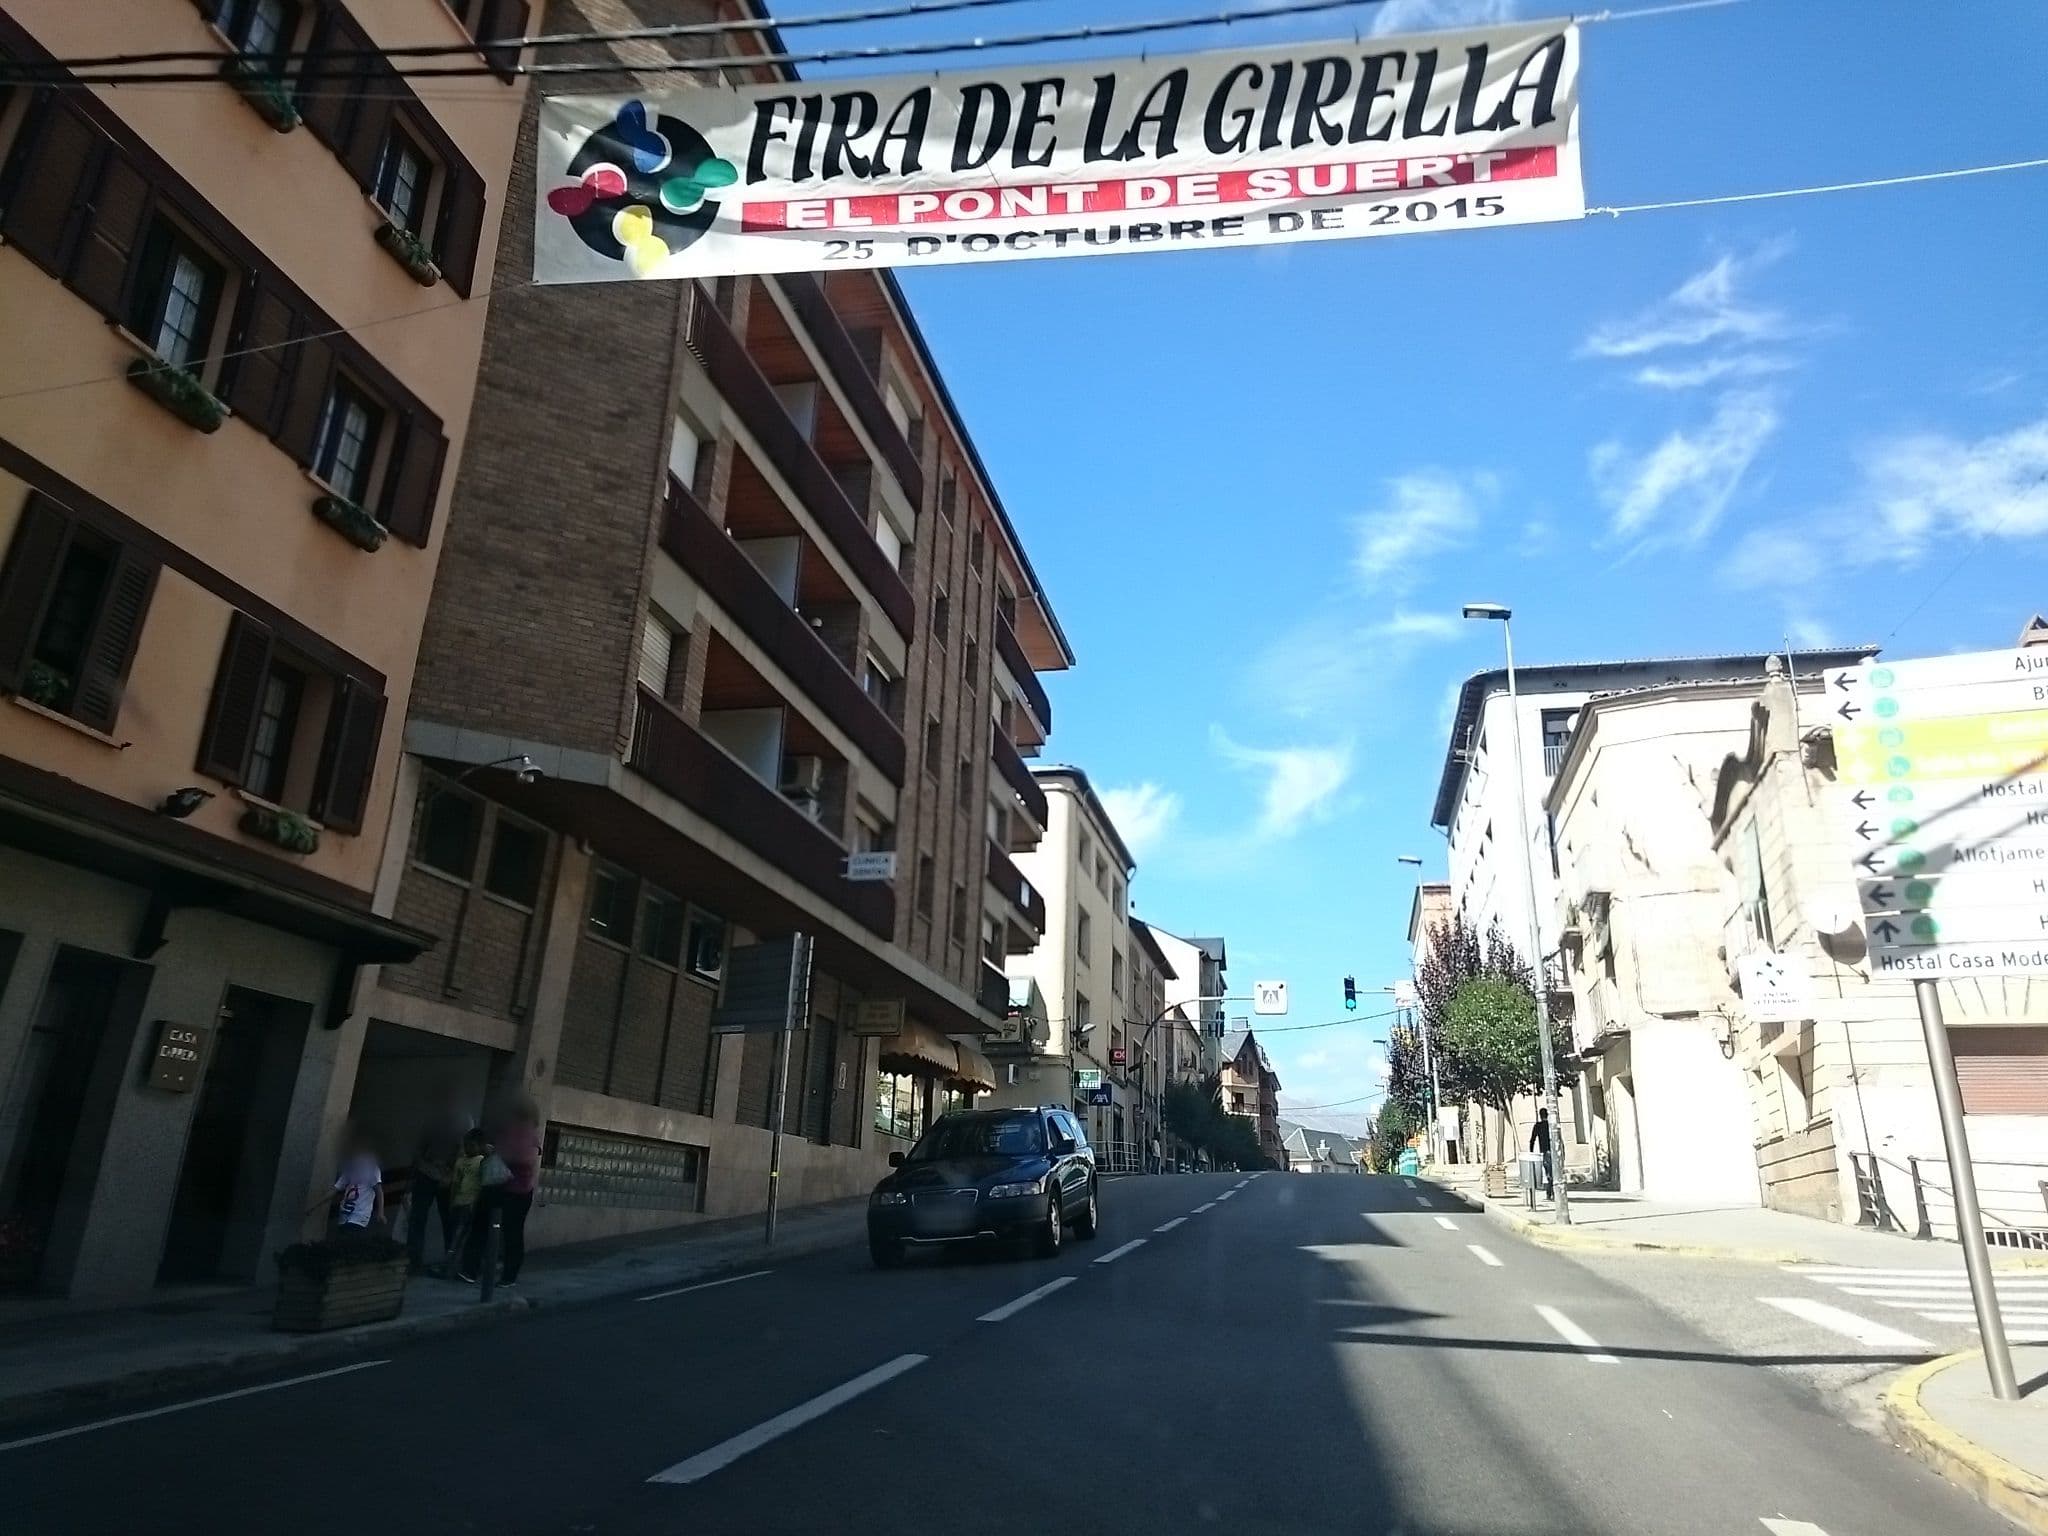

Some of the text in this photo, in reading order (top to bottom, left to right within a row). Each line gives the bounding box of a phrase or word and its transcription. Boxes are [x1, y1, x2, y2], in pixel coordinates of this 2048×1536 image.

[746, 34, 1566, 185] FIRA DE LA GIRELLA
[785, 151, 1507, 229] EL PONT DE SUERT
[822, 196, 1504, 261] 25 D'OCTUBRE DE 2015
[1982, 779, 2043, 798] Hostal
[1880, 953, 1942, 971] Hostal
[1949, 952, 1994, 969] Casa
